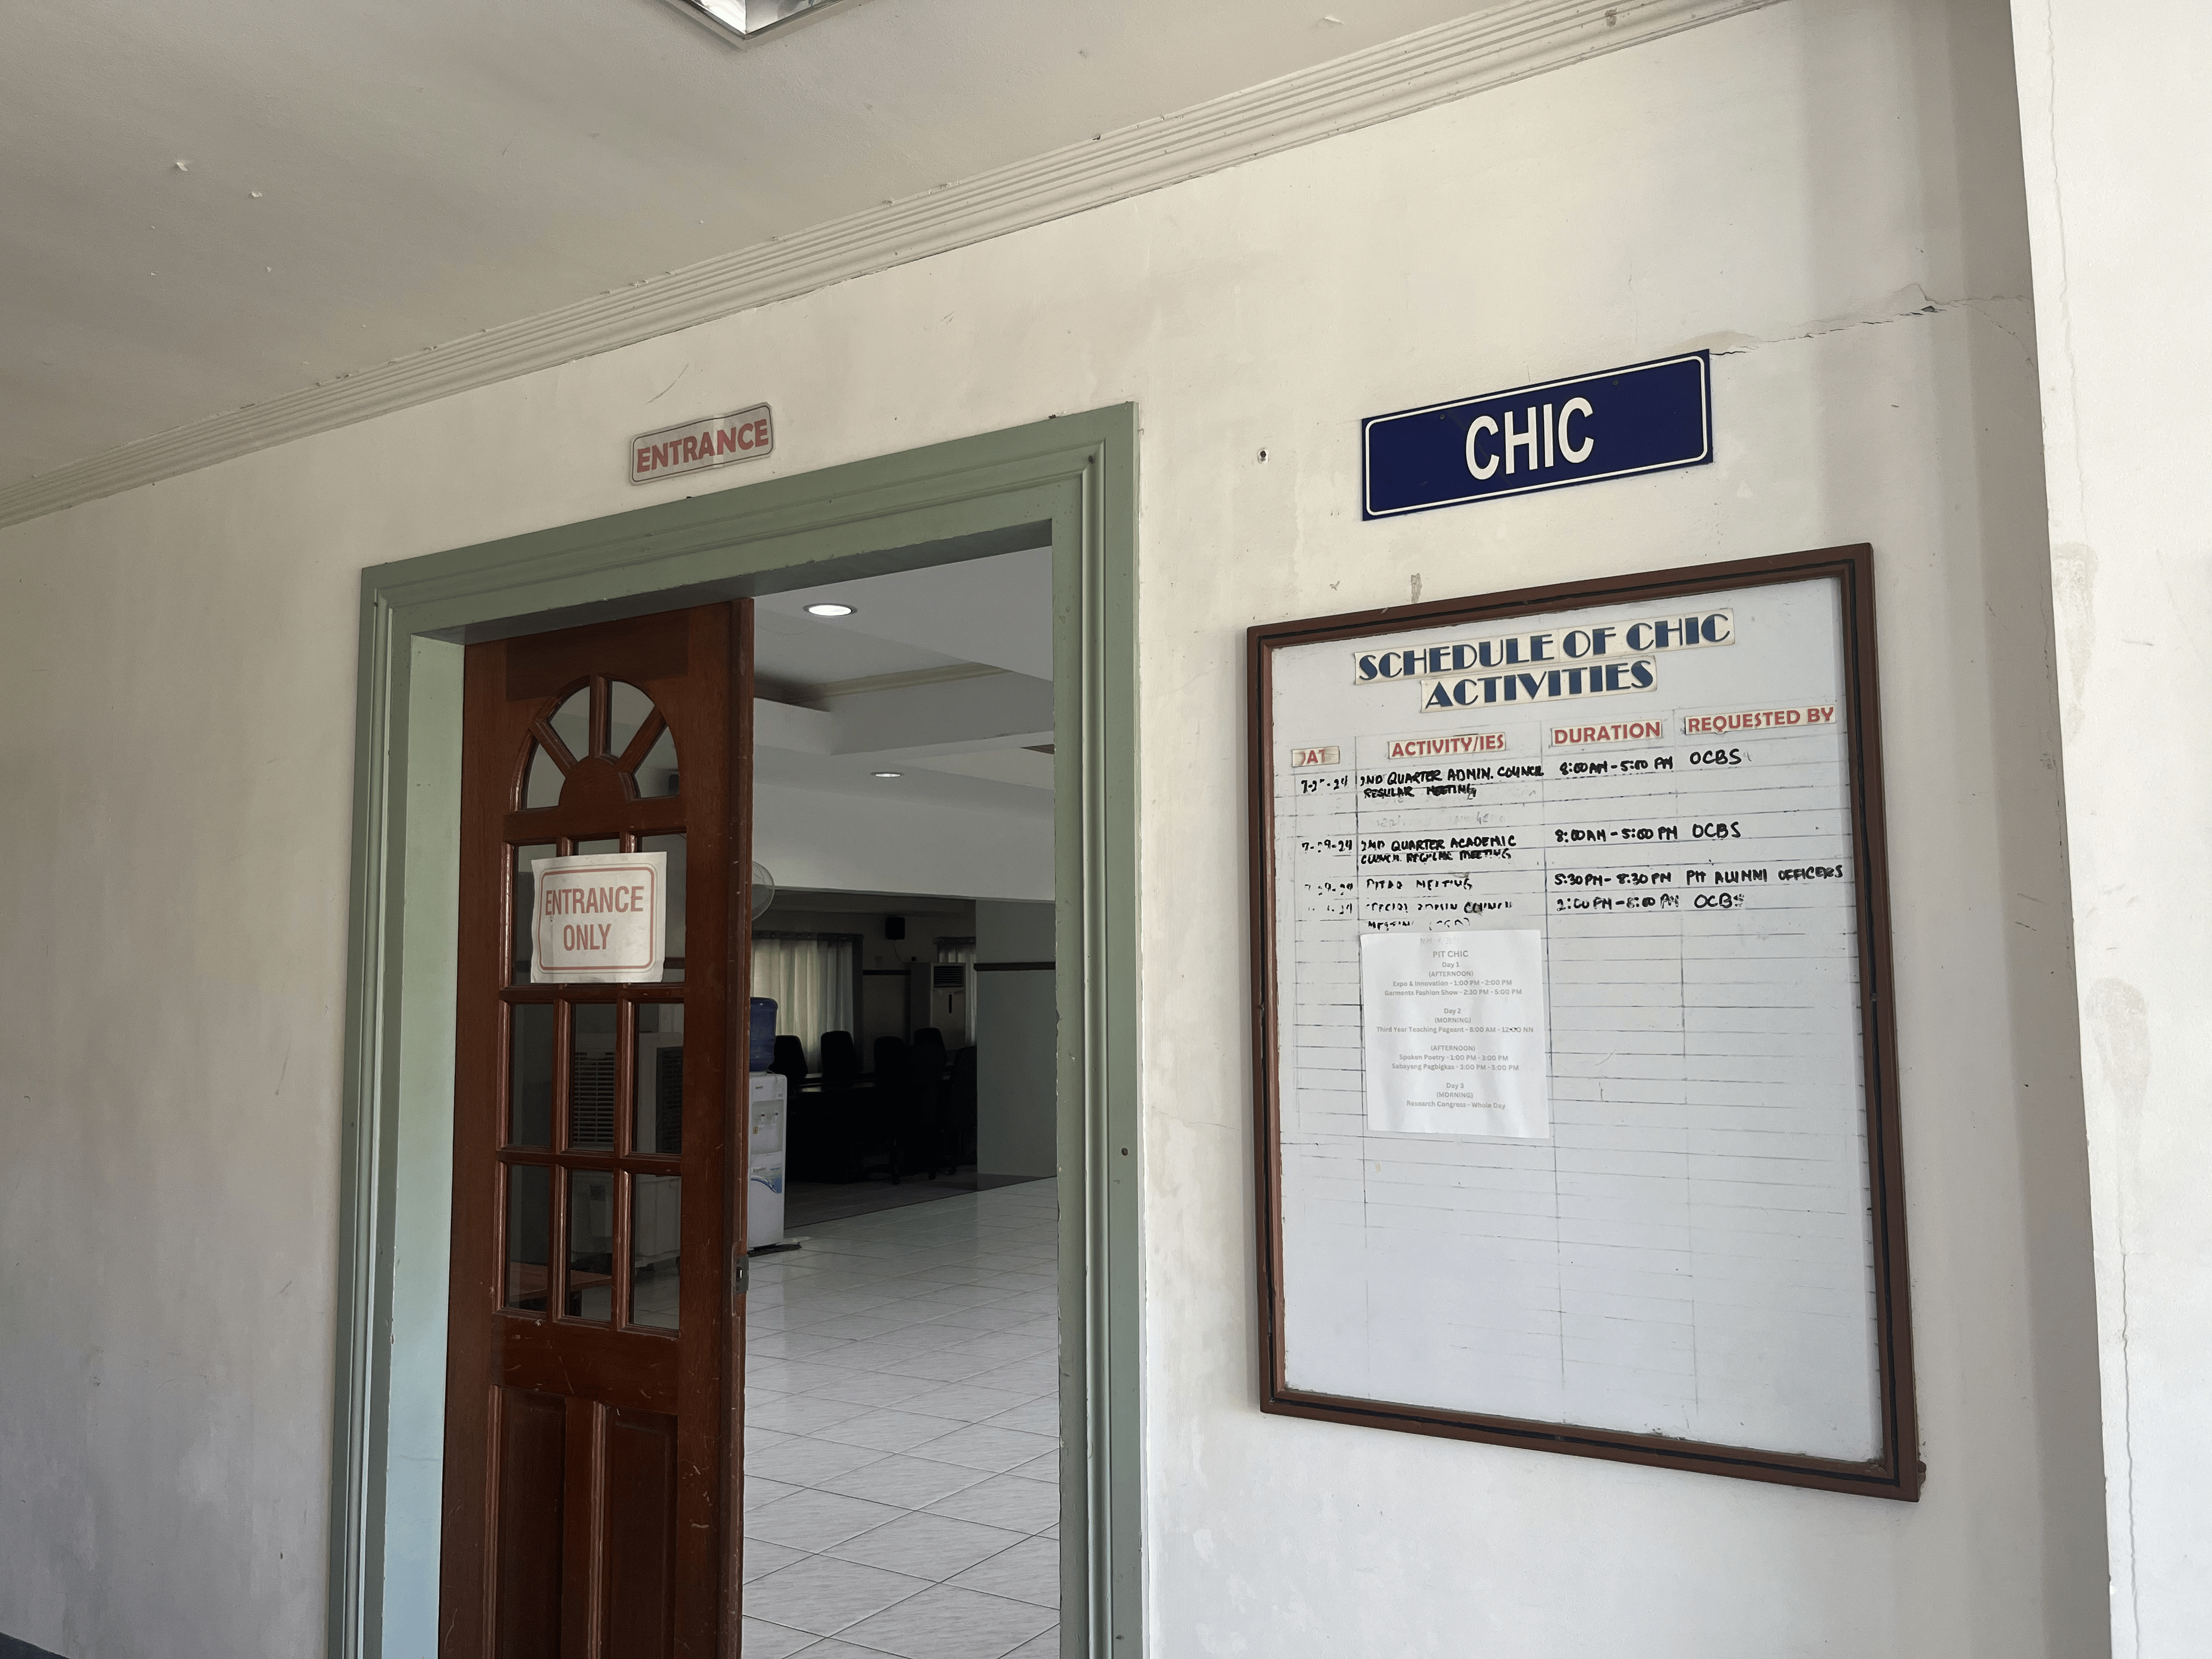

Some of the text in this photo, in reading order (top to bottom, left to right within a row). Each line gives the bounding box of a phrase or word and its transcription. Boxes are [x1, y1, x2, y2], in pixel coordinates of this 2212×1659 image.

[636, 419, 769, 473] ENTRANCE
[1465, 397, 1594, 480] CHIC
[1358, 613, 1731, 680] SCHEDULE OF CHIC
[1425, 659, 1654, 709] ACTIVITIES
[1688, 707, 1834, 733] REQUESTED BY
[1554, 721, 1661, 745] DURATION
[1391, 733, 1504, 758] ACTIVITY/IES
[1654, 755, 1673, 770] PM
[1690, 748, 1742, 765] OCBS
[1387, 770, 1443, 785] QUARTER
[1658, 825, 1678, 840] PM
[1692, 821, 1741, 839] OCBS
[1361, 835, 1517, 851] 2ND QUARTER ACADEMIC
[1459, 847, 1512, 861] MEETING
[1714, 868, 1768, 885] ALUMNI
[545, 885, 645, 916] ENTRANCE
[1365, 902, 1408, 913] PECIAL
[1694, 892, 1745, 909] OCBS
[563, 923, 612, 951] ONLY
[1408, 1026, 1437, 1034] Teaching
[1424, 1054, 1445, 1062] Poetry
[1423, 1063, 1455, 1071] Pagbigkas
